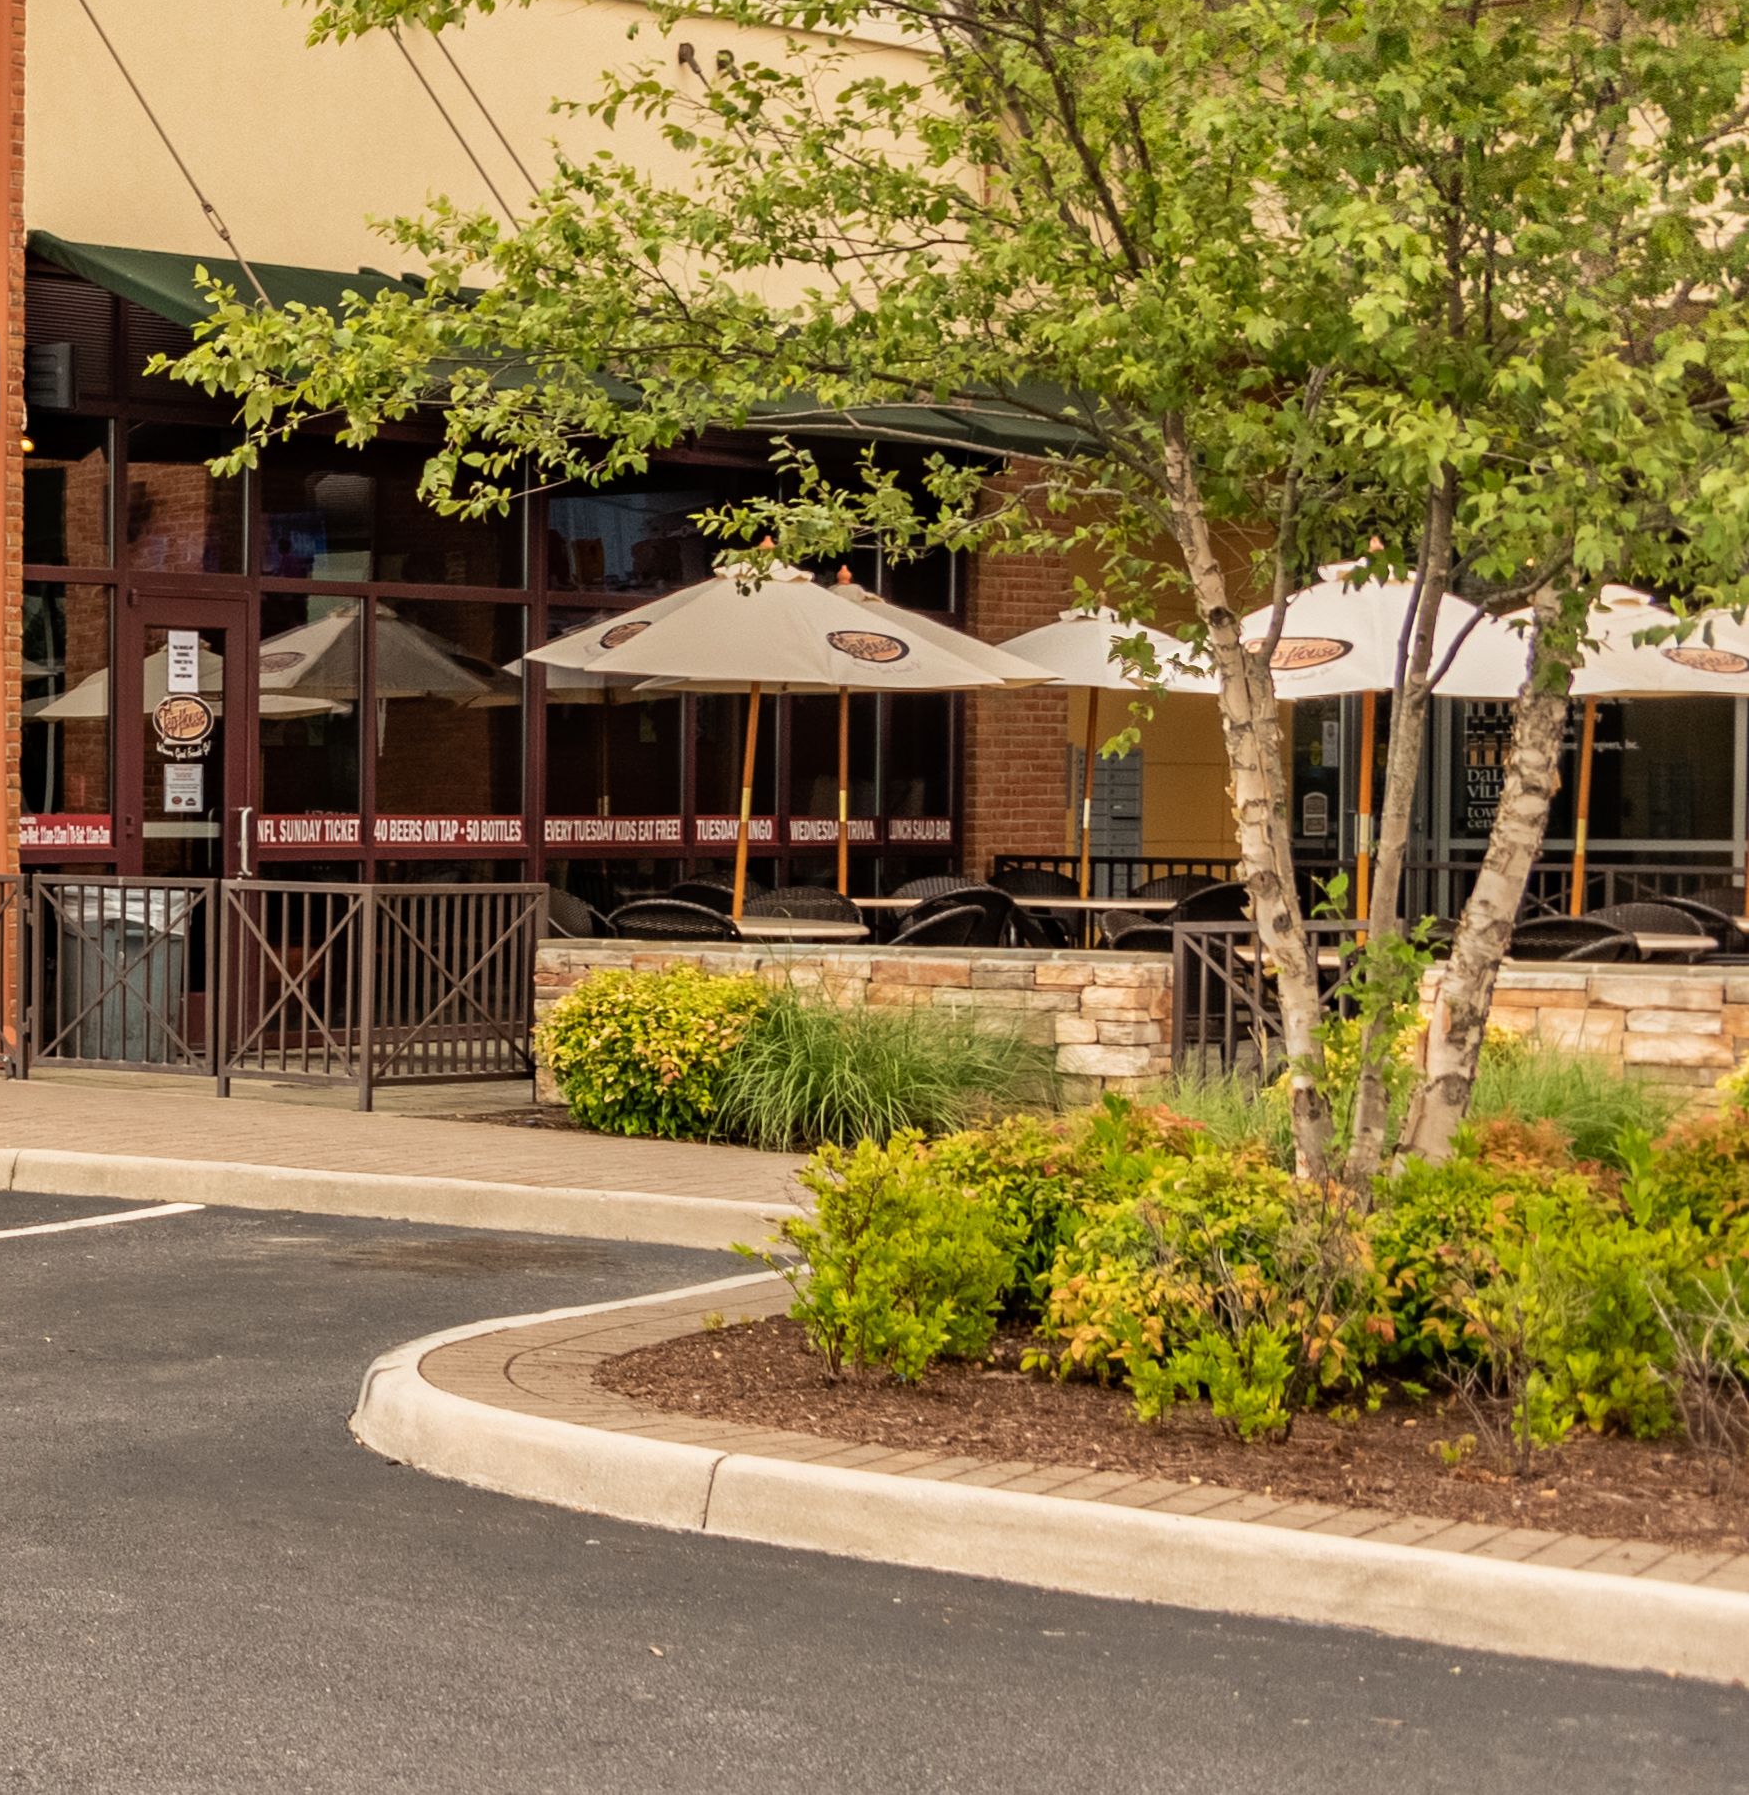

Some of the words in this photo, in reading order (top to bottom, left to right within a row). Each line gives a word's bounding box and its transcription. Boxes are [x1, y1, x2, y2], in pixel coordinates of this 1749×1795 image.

[256, 819, 276, 843] NFL
[279, 819, 323, 843] SUNDAY
[324, 819, 361, 843] TICKET
[373, 819, 387, 843] 40
[389, 819, 423, 843] BEERS
[424, 819, 438, 843] ON
[439, 819, 458, 843] TAP
[466, 819, 479, 843] 50
[481, 819, 522, 843] BOTTLES
[544, 820, 573, 842] EVERY
[574, 820, 614, 842] TUESDAY
[615, 820, 637, 842] KIDS
[638, 820, 654, 842] EAT
[696, 820, 739, 841] TUESDAY
[748, 820, 772, 841] INGO
[790, 820, 839, 841] WEDNESDA
[847, 820, 875, 841] TRIVIA
[912, 821, 935, 841] SALAD
[935, 821, 951, 841] BAR
